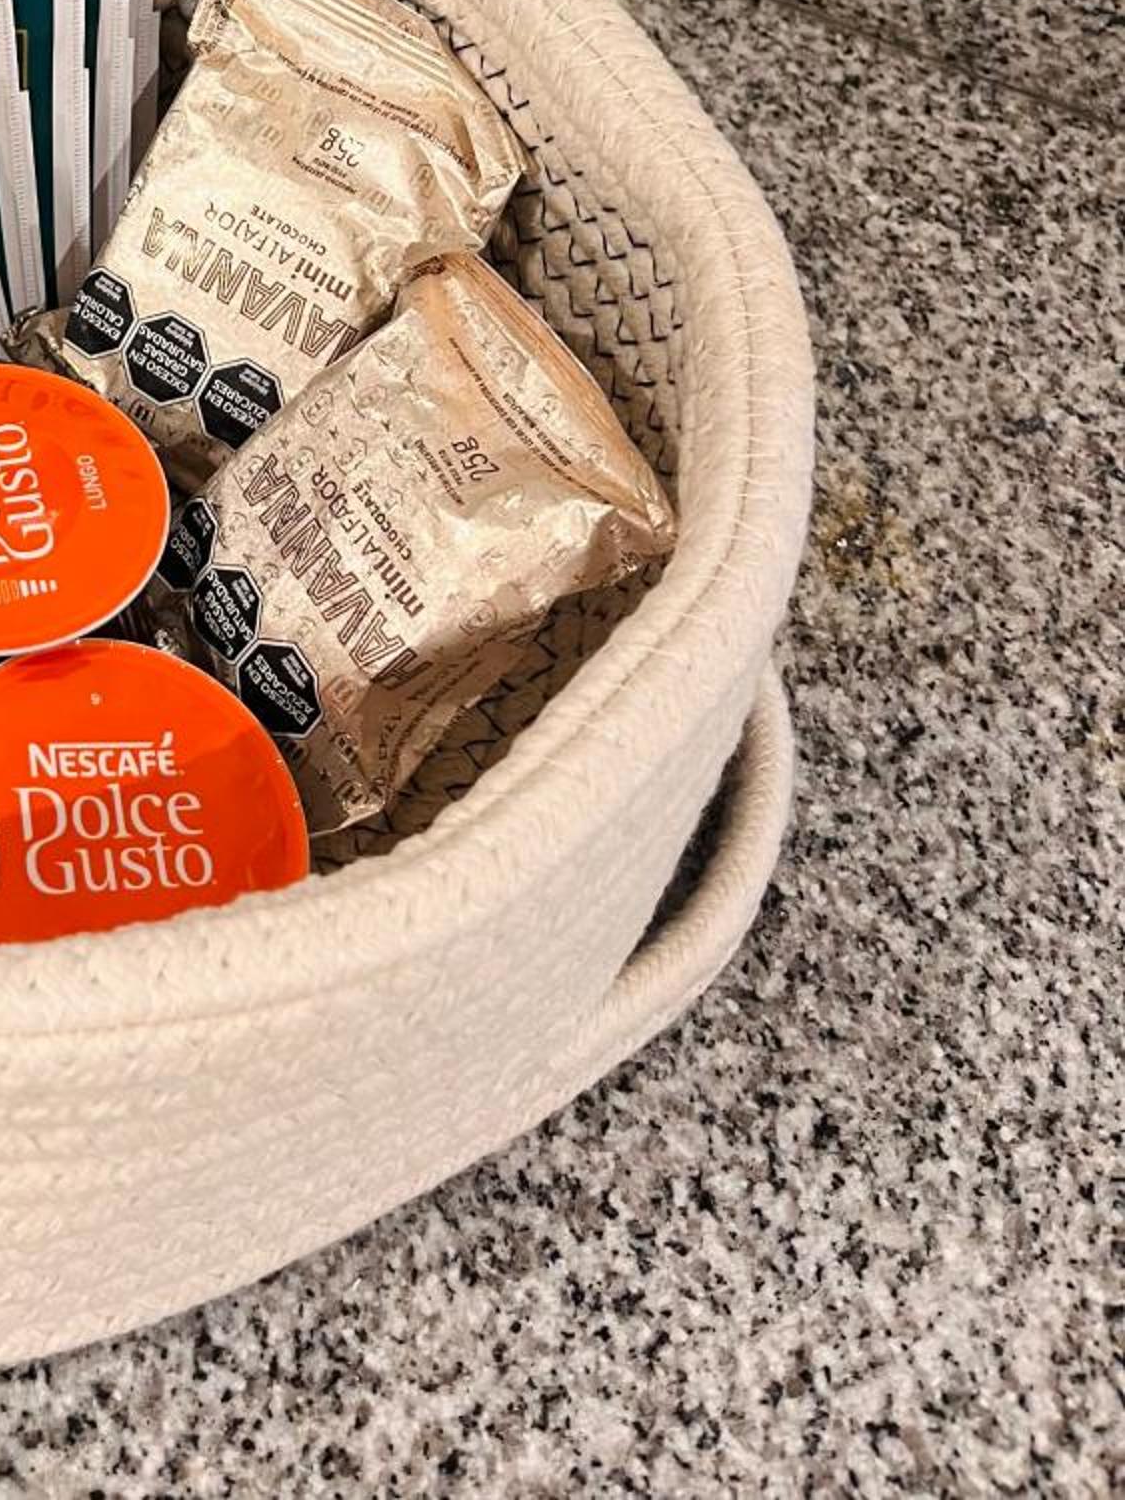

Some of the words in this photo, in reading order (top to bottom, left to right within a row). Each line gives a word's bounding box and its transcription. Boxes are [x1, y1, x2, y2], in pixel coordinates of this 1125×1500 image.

[200, 199, 295, 268] ALFAJOR
[247, 201, 327, 258] CHOCOLATE
[289, 255, 353, 308] mini
[78, 307, 122, 340] EXCESO
[137, 323, 207, 372] SATURADAS
[128, 348, 147, 366] EN
[141, 341, 189, 377] GRASAS
[144, 358, 191, 393] EXCESO
[204, 388, 224, 407] EN
[221, 399, 262, 430] XCESO
[77, 455, 107, 510] LUNGO
[449, 435, 500, 483] 25g
[307, 462, 384, 564] ALFAJOR
[350, 477, 415, 561] CHOCOLATE
[240, 451, 433, 689] HAVANNA
[369, 555, 427, 619] mini
[202, 589, 239, 639] GRASAS
[203, 568, 256, 642] SATURADAS
[243, 663, 263, 684] EN
[258, 681, 309, 725] EXCESO
[28, 731, 176, 778] NESCAFÉ
[11, 783, 203, 842] Dolce
[26, 837, 213, 895] Gusto
